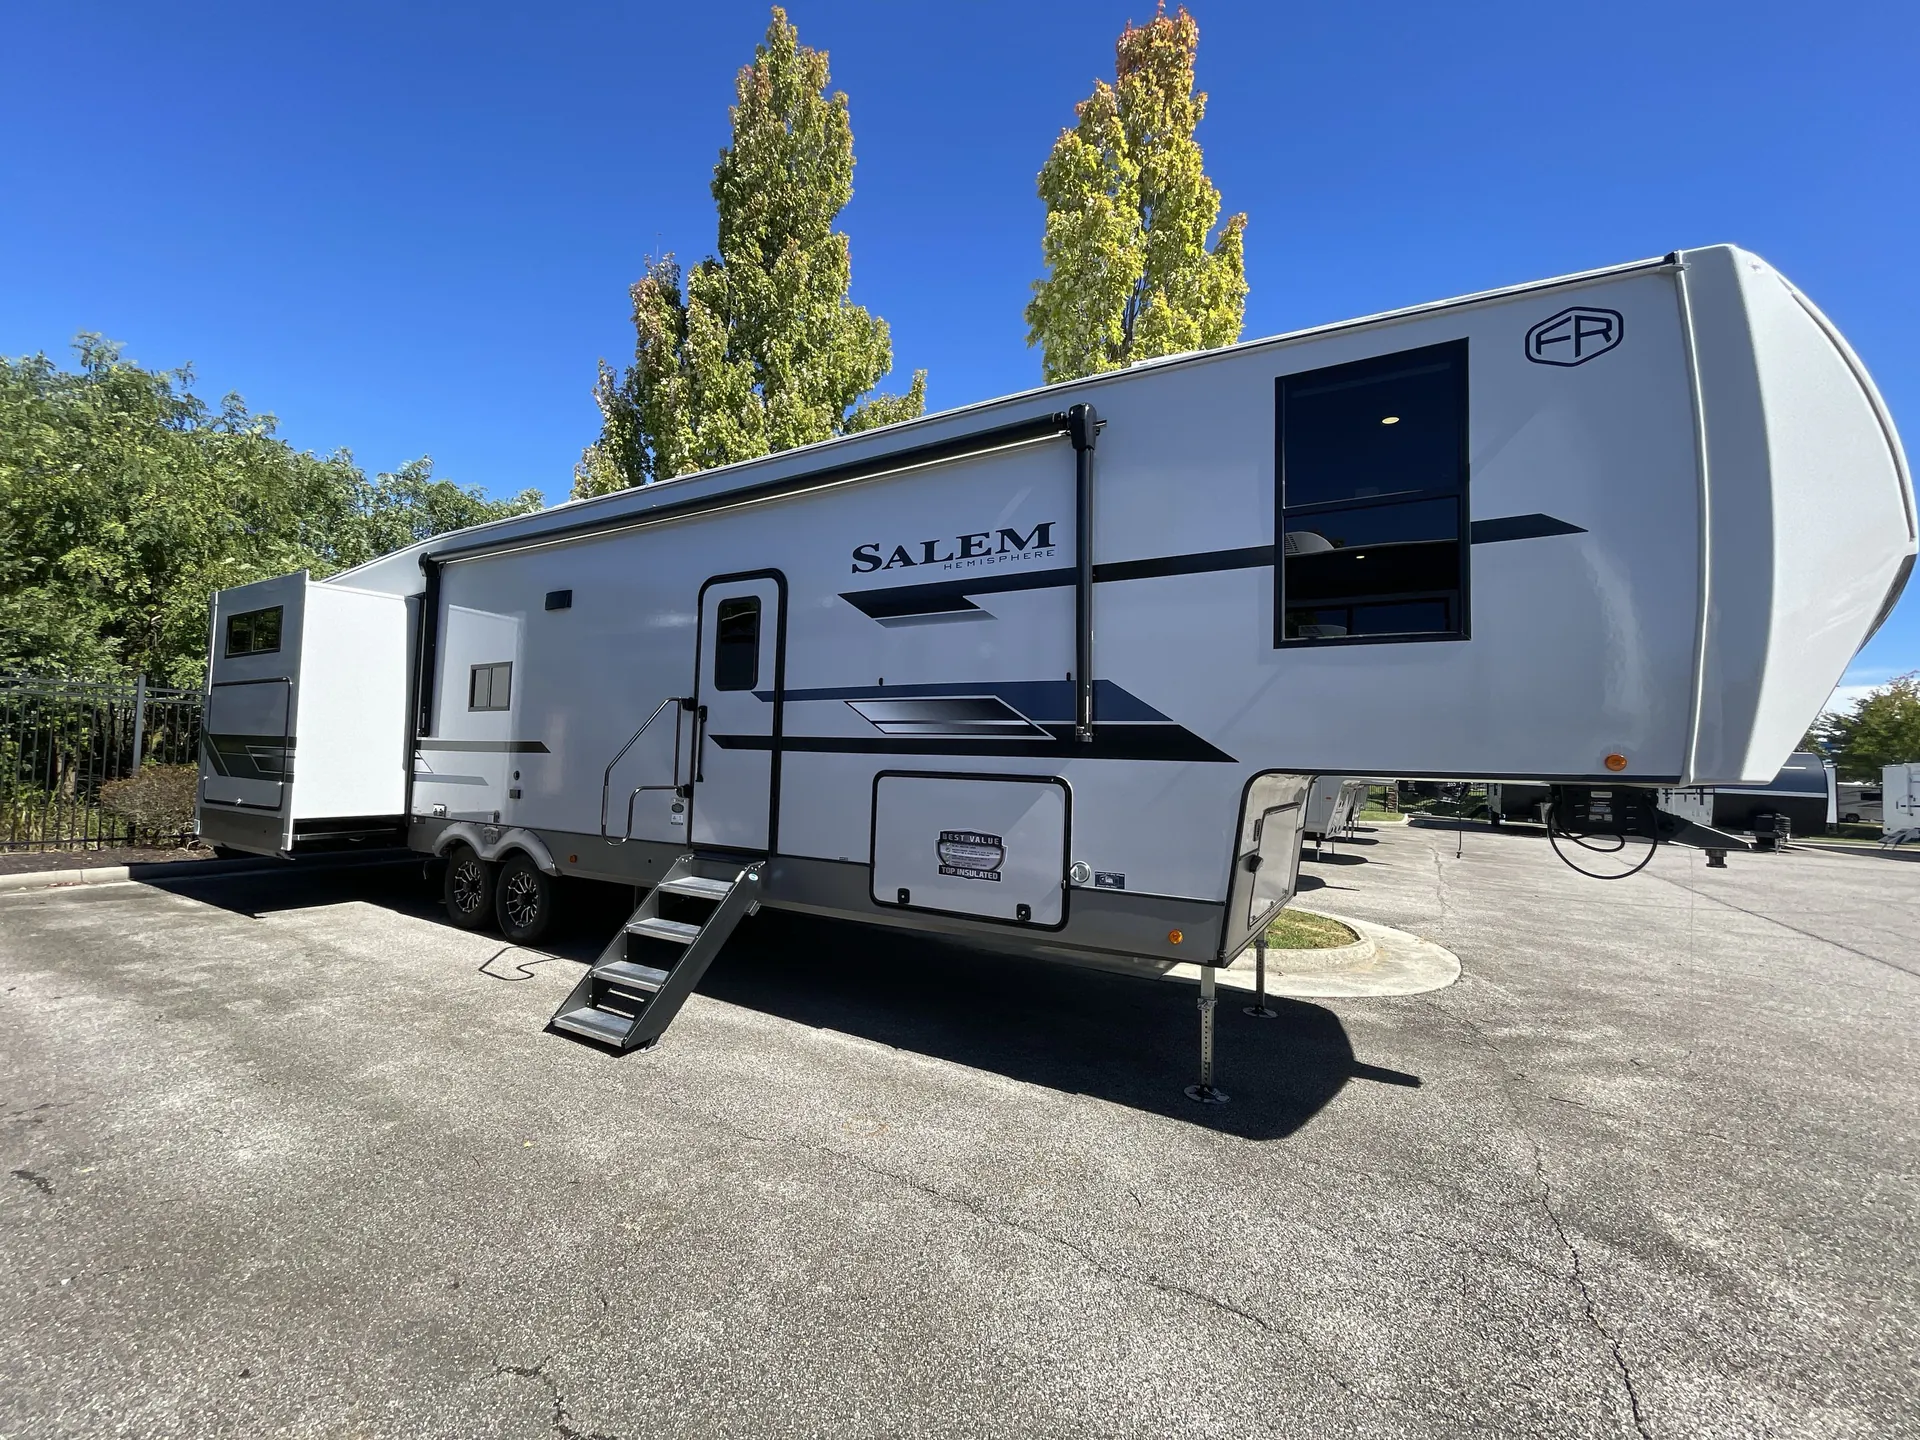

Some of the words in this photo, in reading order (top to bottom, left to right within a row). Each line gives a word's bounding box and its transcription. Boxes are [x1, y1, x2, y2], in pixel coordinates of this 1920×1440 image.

[851, 521, 1056, 574] SALEM
[943, 549, 1055, 571] HEMISPHERE
[942, 833, 965, 841] BEST
[969, 835, 1000, 844] VALUE
[941, 866, 955, 874] TOP
[957, 869, 998, 880] INSULATED
